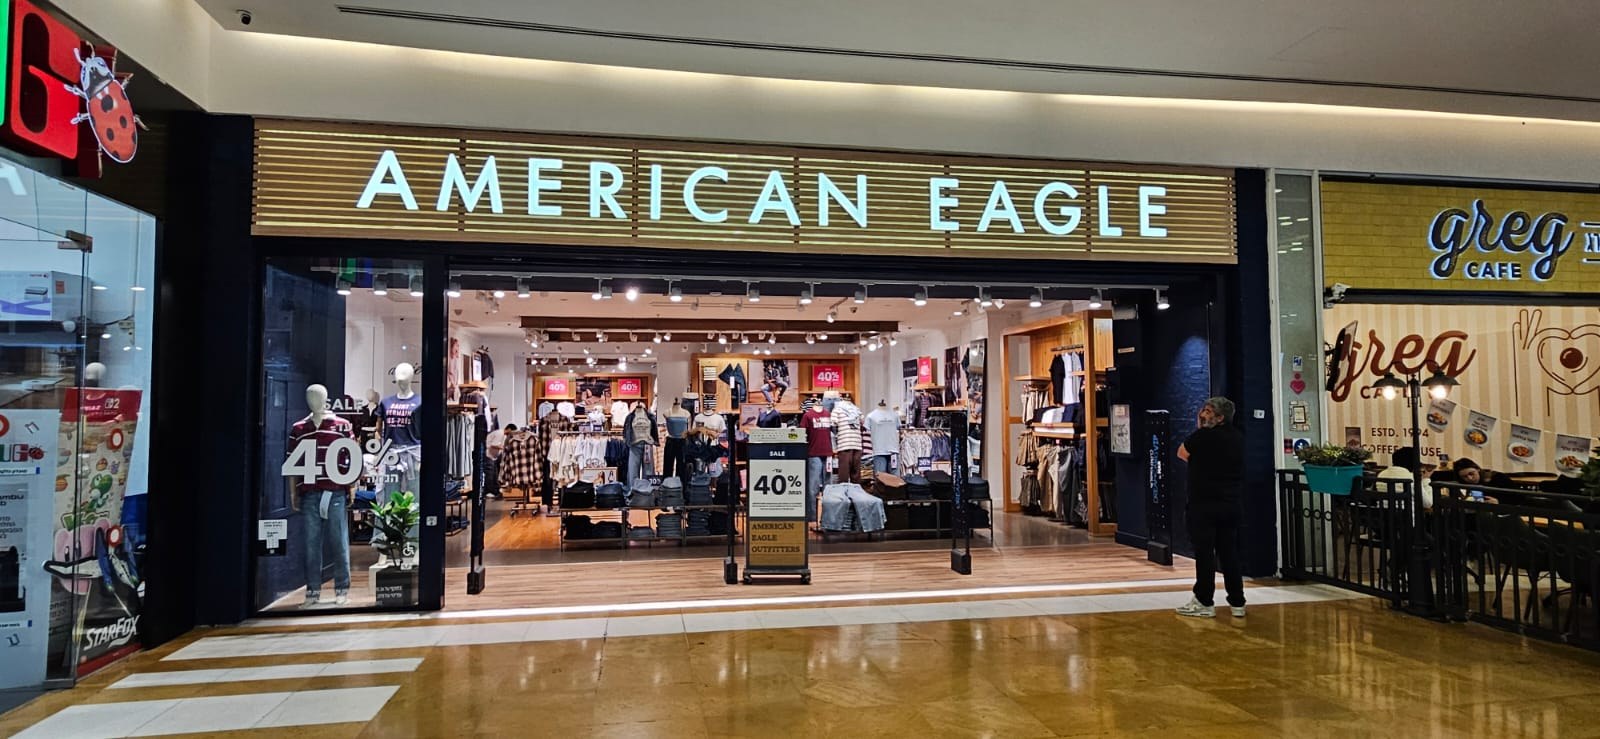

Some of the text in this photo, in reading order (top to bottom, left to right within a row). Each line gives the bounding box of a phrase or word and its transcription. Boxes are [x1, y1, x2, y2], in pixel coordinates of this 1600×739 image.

[356, 150, 1168, 238] AMERICAN EAGLE
[1428, 199, 1576, 282] greg
[1465, 261, 1522, 280] CAFE
[1371, 427, 1399, 438] ESTD.
[281, 438, 400, 486] 40%
[753, 474, 802, 496] 40%
[751, 522, 795, 530] AMERICAN
[751, 545, 801, 553] OUTFITTERS
